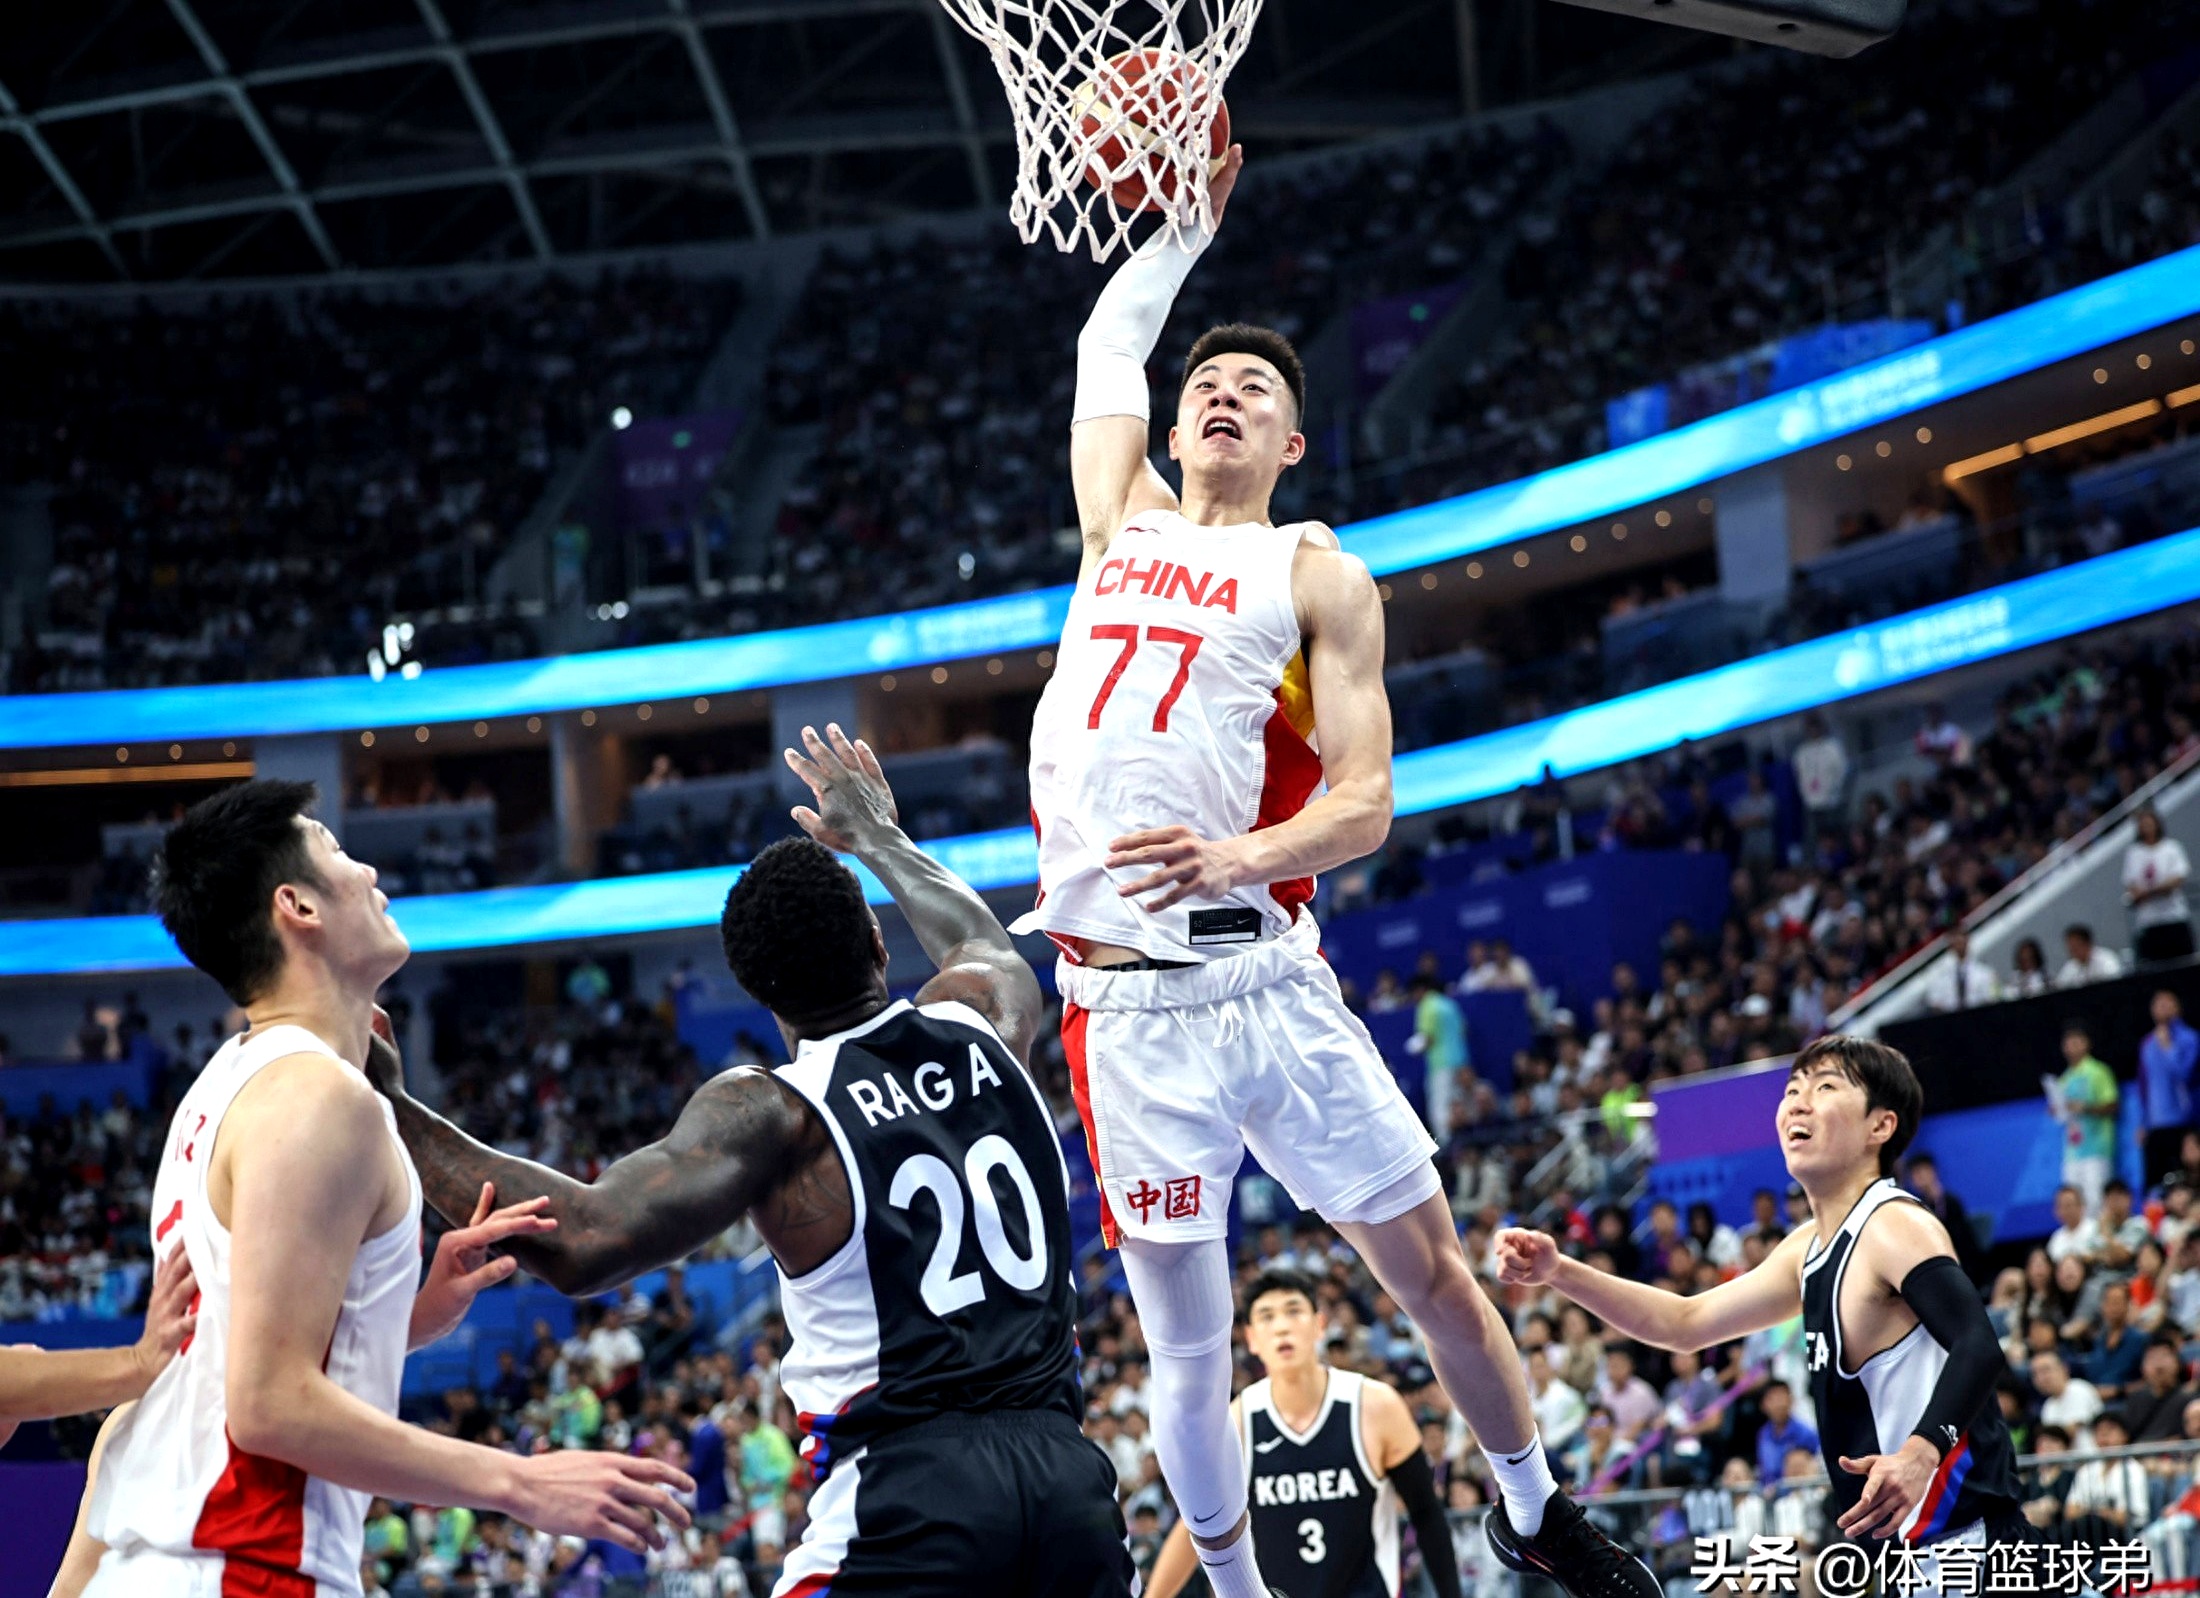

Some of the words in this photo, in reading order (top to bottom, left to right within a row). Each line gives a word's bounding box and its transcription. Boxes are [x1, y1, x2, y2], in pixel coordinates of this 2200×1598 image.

[1095, 557, 1238, 614] CHINA
[1087, 624, 1204, 733] 77
[846, 1042, 1003, 1127] RAGA
[889, 1134, 1048, 1317] 20
[1126, 1175, 1202, 1226] 中国
[1255, 1467, 1359, 1506] KOREA
[1297, 1518, 1327, 1564] 3
